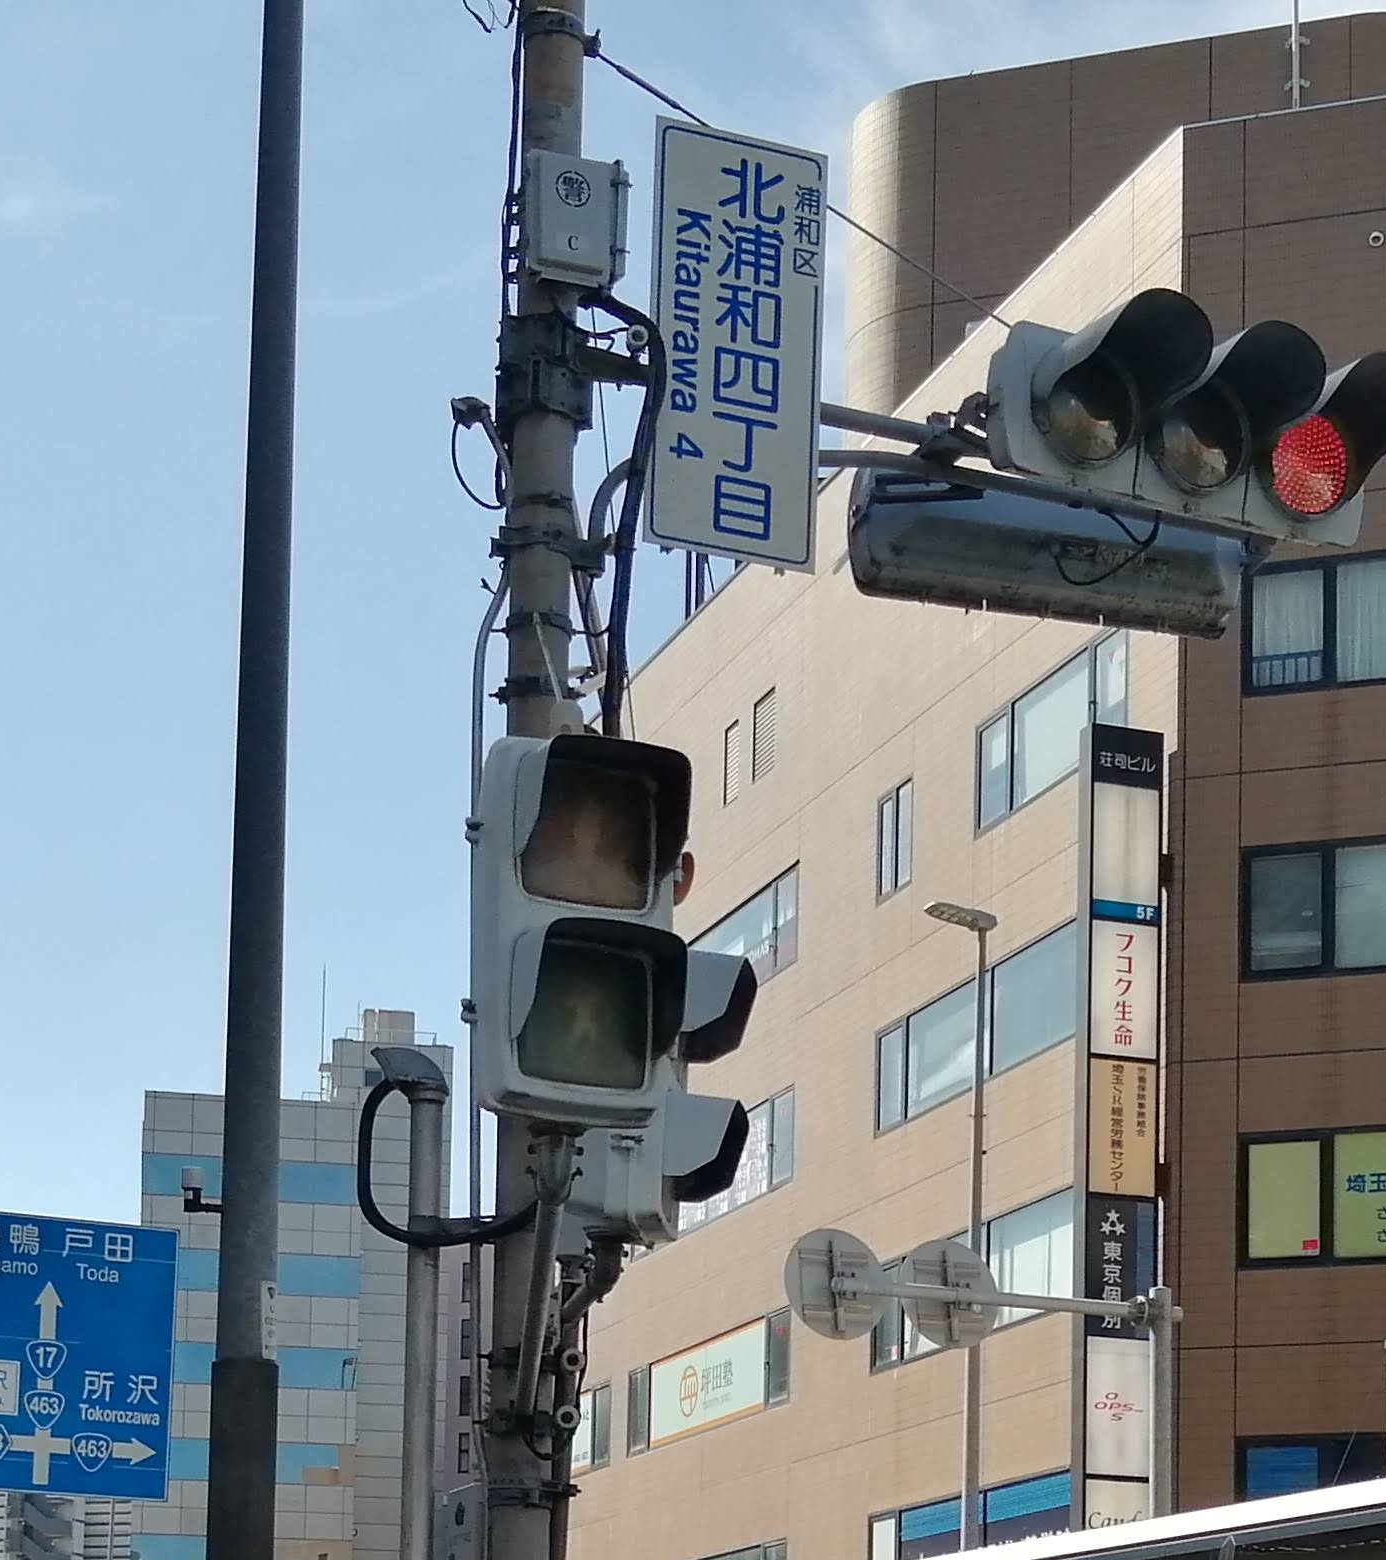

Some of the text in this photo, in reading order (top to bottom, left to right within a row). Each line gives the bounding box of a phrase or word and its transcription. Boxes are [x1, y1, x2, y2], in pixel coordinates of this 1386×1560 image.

[792, 183, 822, 278] 浦和区
[567, 235, 579, 251] C
[669, 207, 712, 461] Kitaurawa 4
[712, 157, 786, 541] 北浦和四丁目
[1136, 906, 1155, 920] 5F
[1113, 932, 1135, 1048] フコク生命
[63, 1227, 134, 1264] 戸田
[76, 1263, 120, 1284] Toda
[34, 1347, 56, 1369] 17
[82, 1369, 159, 1406] 所沢
[29, 1397, 60, 1416] 463
[78, 1403, 161, 1427] Tokorozawa
[76, 1438, 108, 1459] 463
